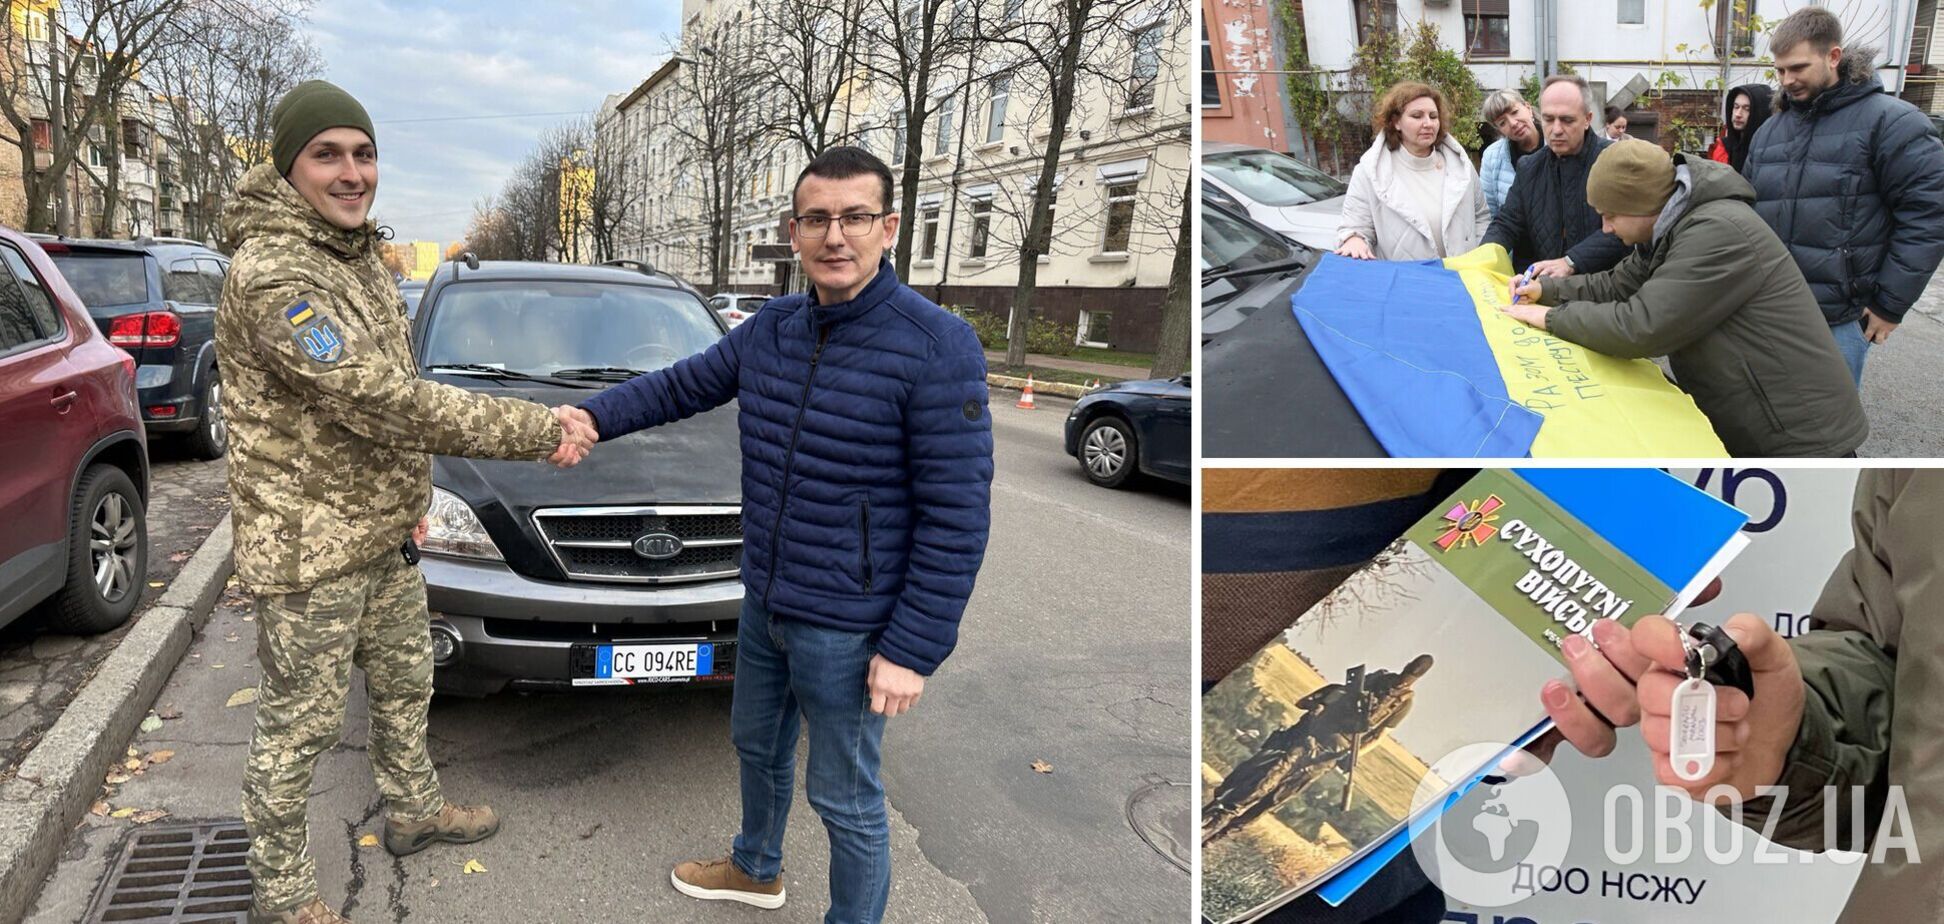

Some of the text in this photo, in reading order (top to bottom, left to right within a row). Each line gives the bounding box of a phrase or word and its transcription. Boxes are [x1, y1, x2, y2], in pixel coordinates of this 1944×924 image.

[642, 539, 676, 553] KIA
[1500, 519, 1634, 622] СУХОПУТНІ
[614, 650, 696, 673] CG 094RE
[1512, 862, 1706, 905] ДОО НСЖУ
